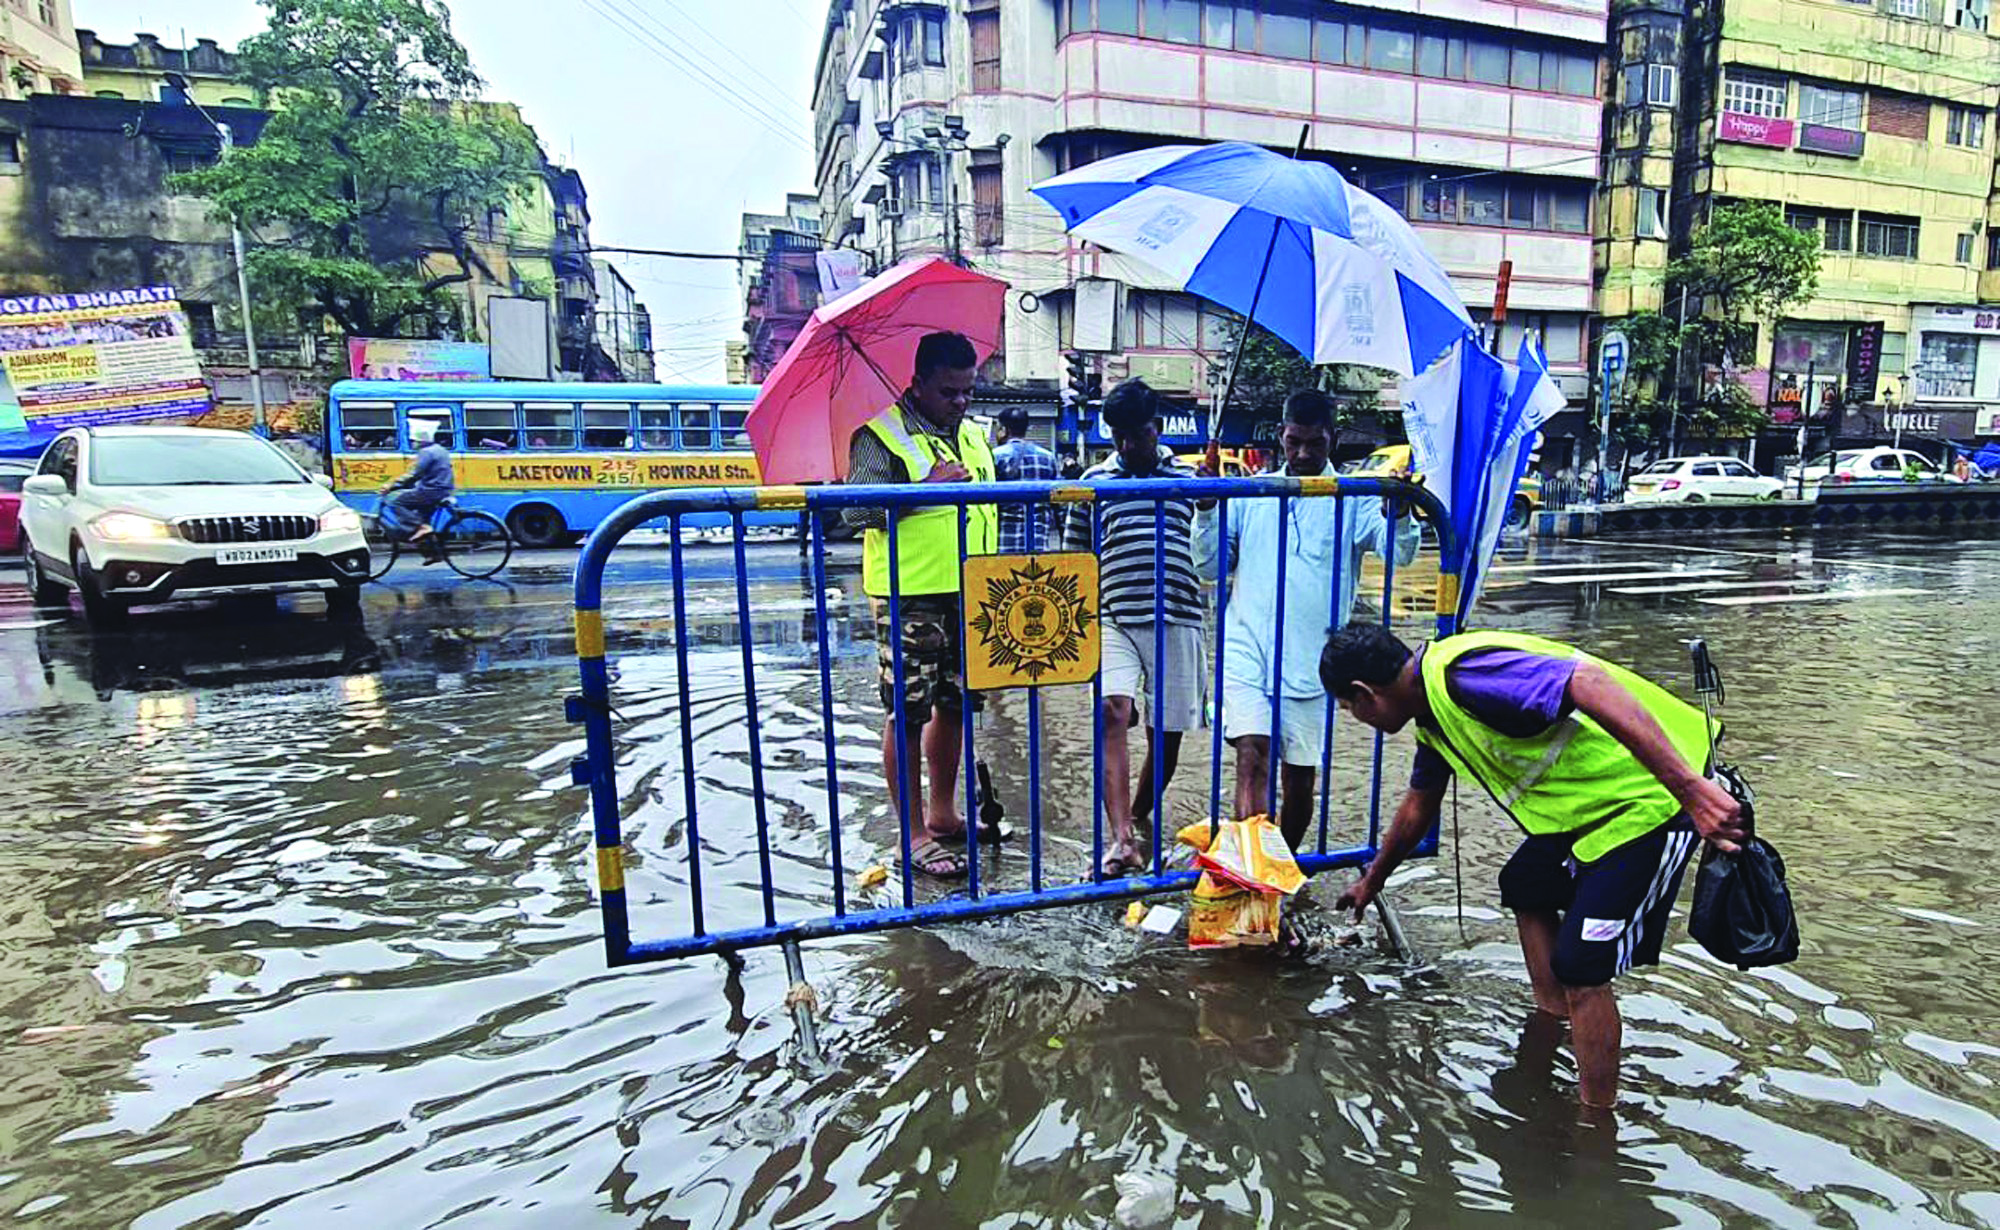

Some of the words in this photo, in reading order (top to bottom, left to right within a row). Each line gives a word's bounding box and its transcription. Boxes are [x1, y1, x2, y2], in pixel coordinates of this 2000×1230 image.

[1729, 117, 1769, 138] Happy
[4, 295, 71, 313] GYAN
[78, 287, 176, 306] BHARATI
[9, 351, 68, 367] ADMISSION
[70, 355, 97, 368] 2022
[497, 464, 593, 481] LAKETOWN
[602, 459, 638, 470] 215
[648, 464, 721, 480] HOWRAH
[724, 464, 756, 480] Stn.
[597, 472, 645, 485] 215/1
[999, 590, 1021, 640] KOLKATA
[1025, 585, 1062, 604] POLICE
[1058, 603, 1072, 637] FORCE
